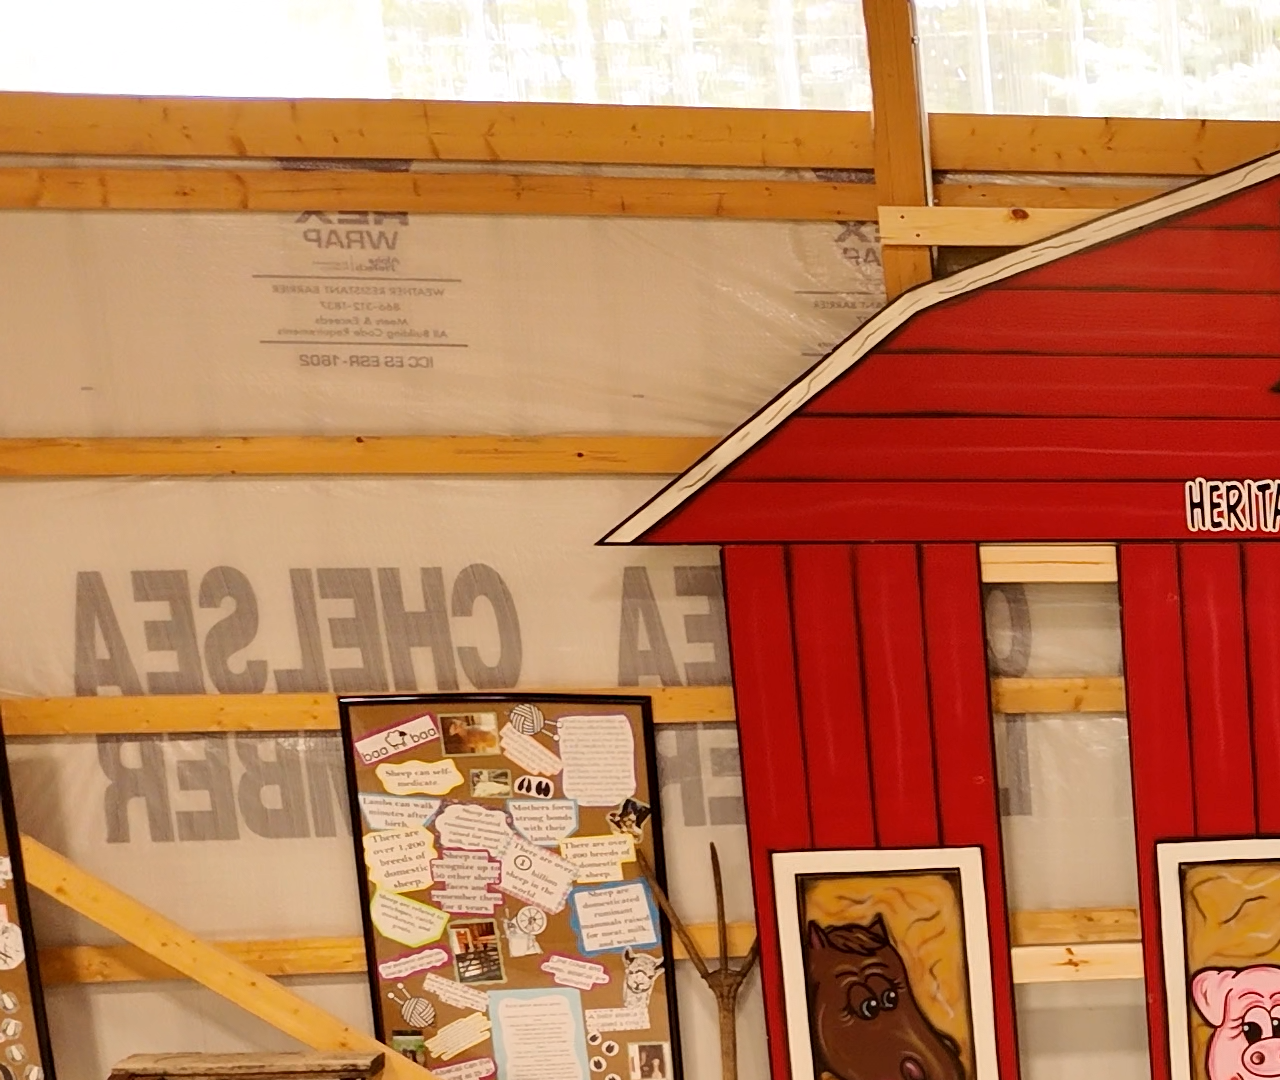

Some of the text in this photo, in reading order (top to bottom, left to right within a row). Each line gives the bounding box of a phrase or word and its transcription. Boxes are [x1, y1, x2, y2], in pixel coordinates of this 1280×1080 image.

[410, 728, 436, 743] baa
[362, 747, 388, 762] baa
[363, 798, 392, 806] Lambs
[371, 830, 420, 844] There are
[373, 841, 426, 855] over 1,200
[379, 852, 413, 866] breeds
[514, 842, 573, 874] There are over
[384, 866, 428, 878] domestic
[393, 880, 424, 888] sheep.
